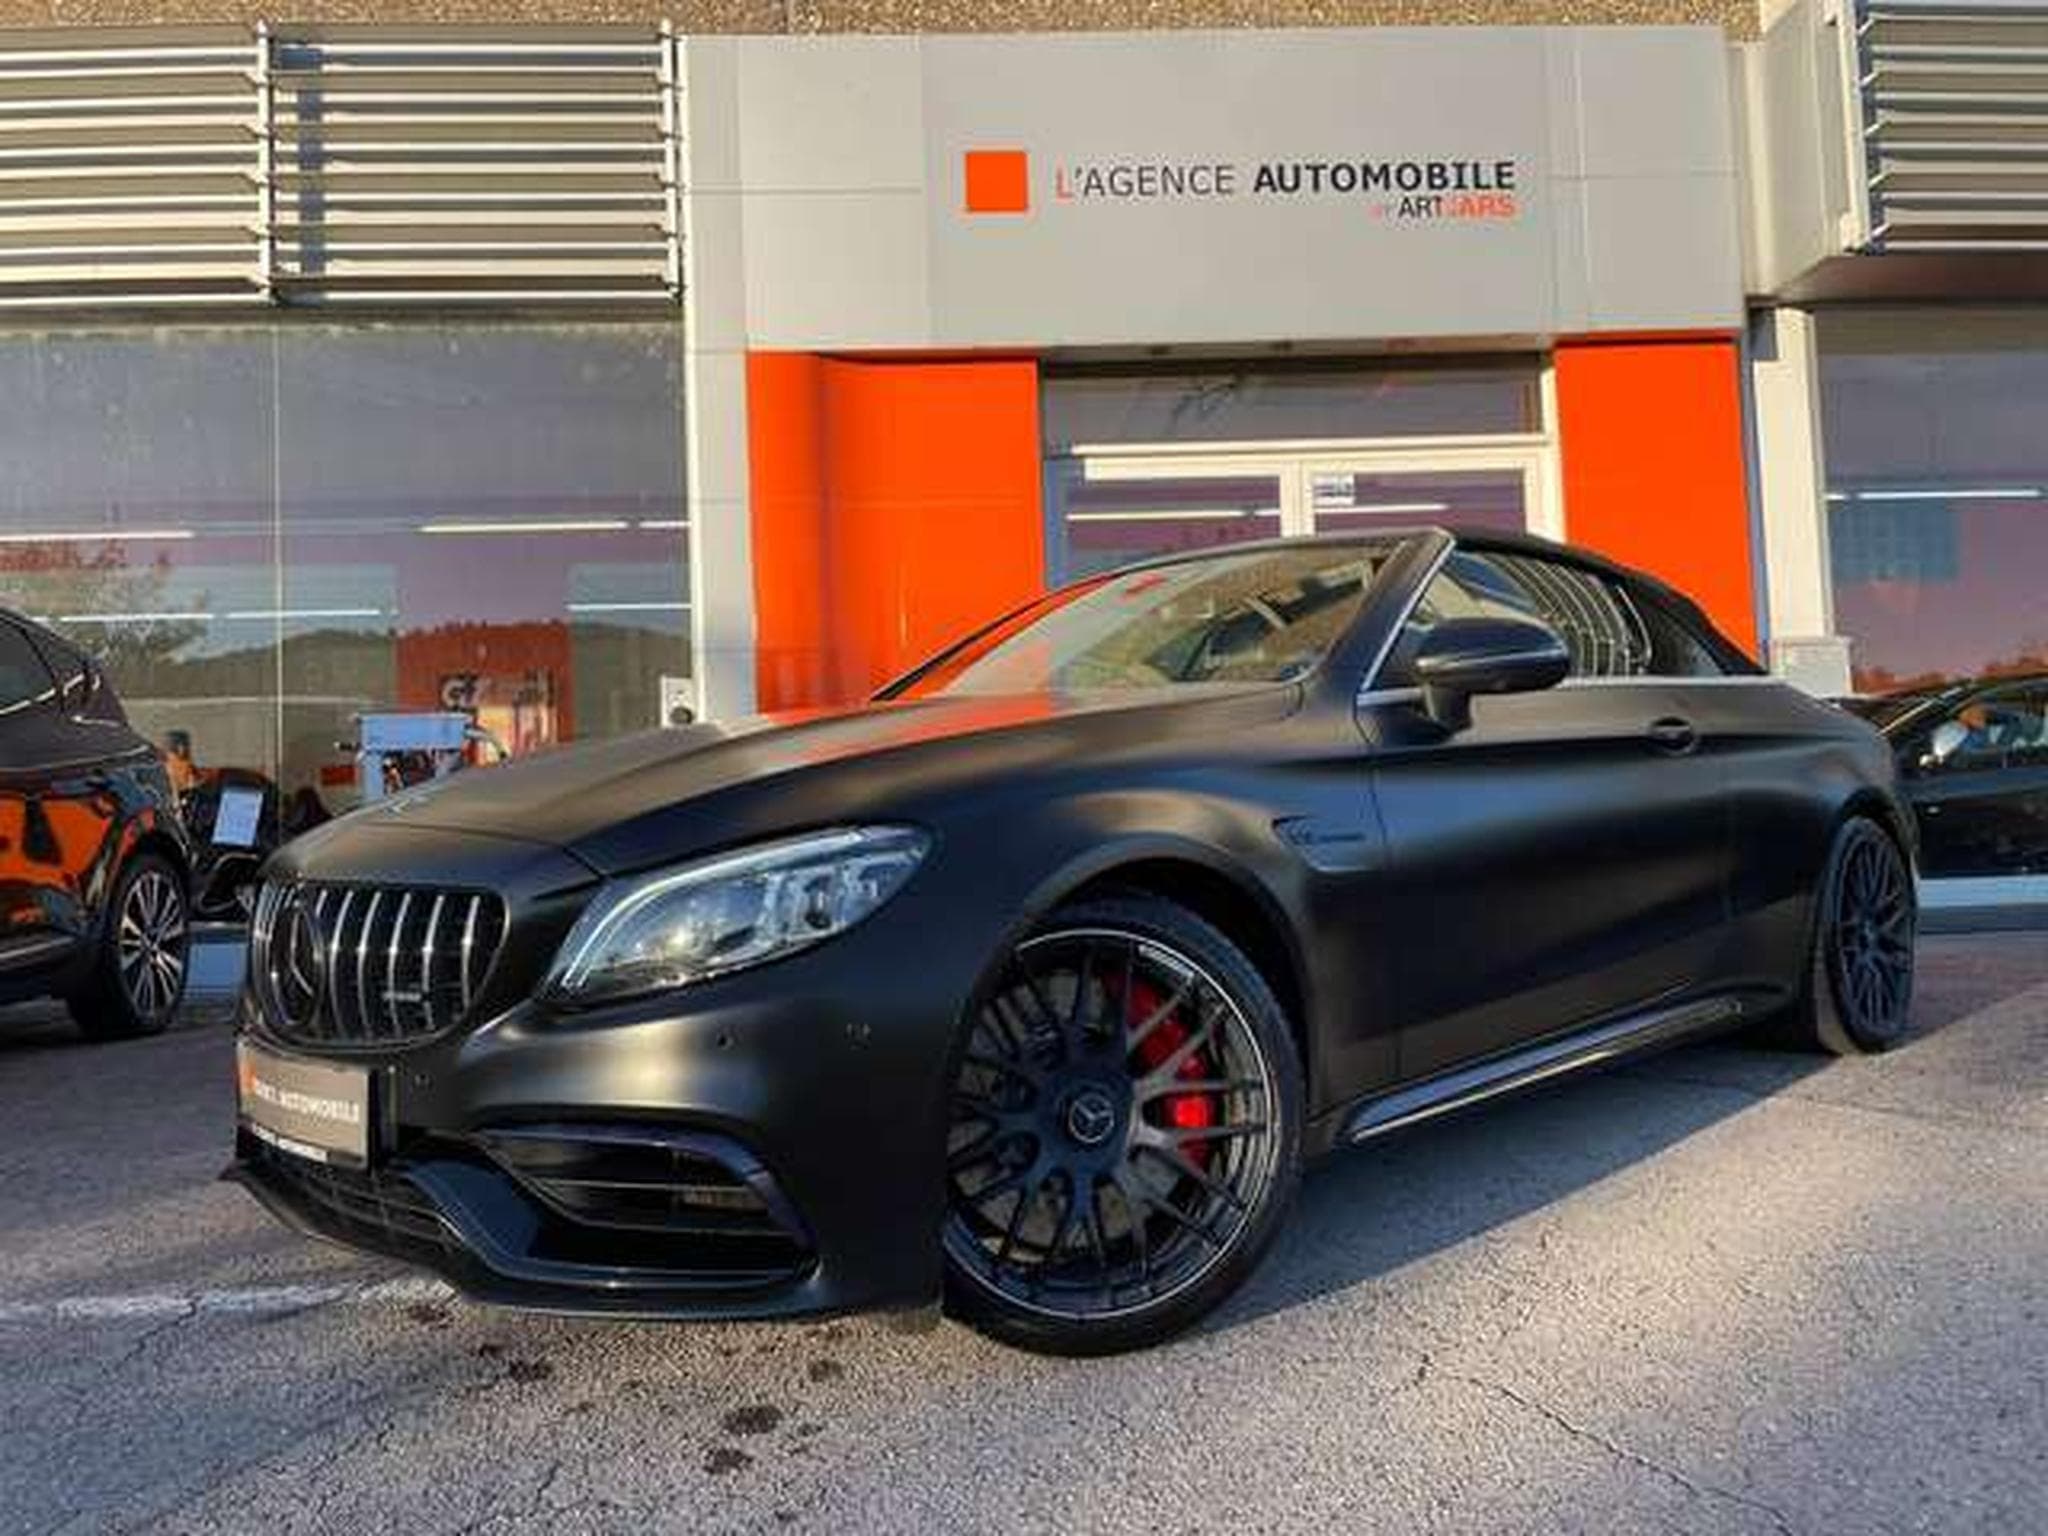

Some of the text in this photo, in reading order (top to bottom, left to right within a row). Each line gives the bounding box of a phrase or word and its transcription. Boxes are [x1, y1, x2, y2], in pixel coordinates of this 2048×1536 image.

[1055, 161, 1516, 199] L'AGENCE AUTOMOBILE
[1398, 196, 1516, 218] ARTARS
